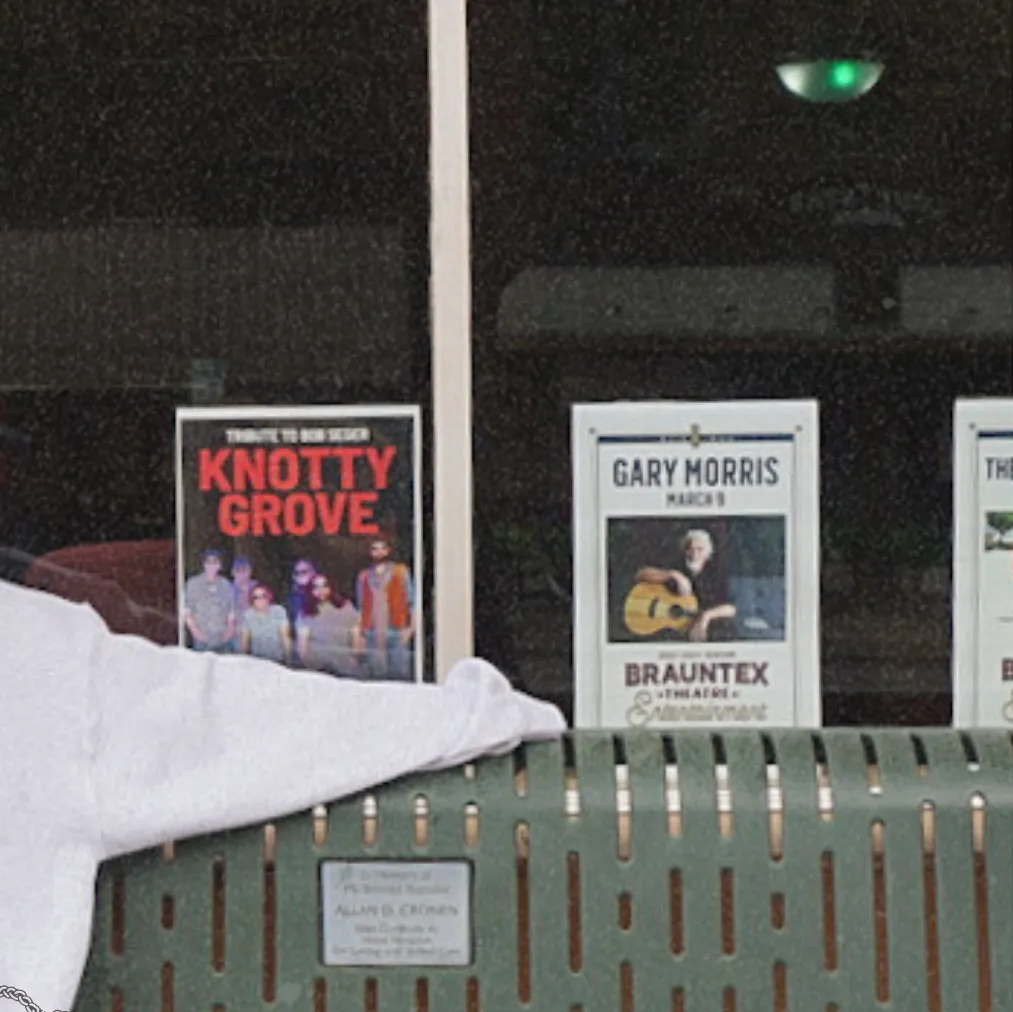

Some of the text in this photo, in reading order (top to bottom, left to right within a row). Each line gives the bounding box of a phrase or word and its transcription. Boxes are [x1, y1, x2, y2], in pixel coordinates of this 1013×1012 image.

[198, 446, 397, 491] KNOTTY
[613, 456, 779, 487] GARY MORRIS
[219, 492, 379, 536] GROVE
[625, 661, 770, 687] BRAUNTEX
